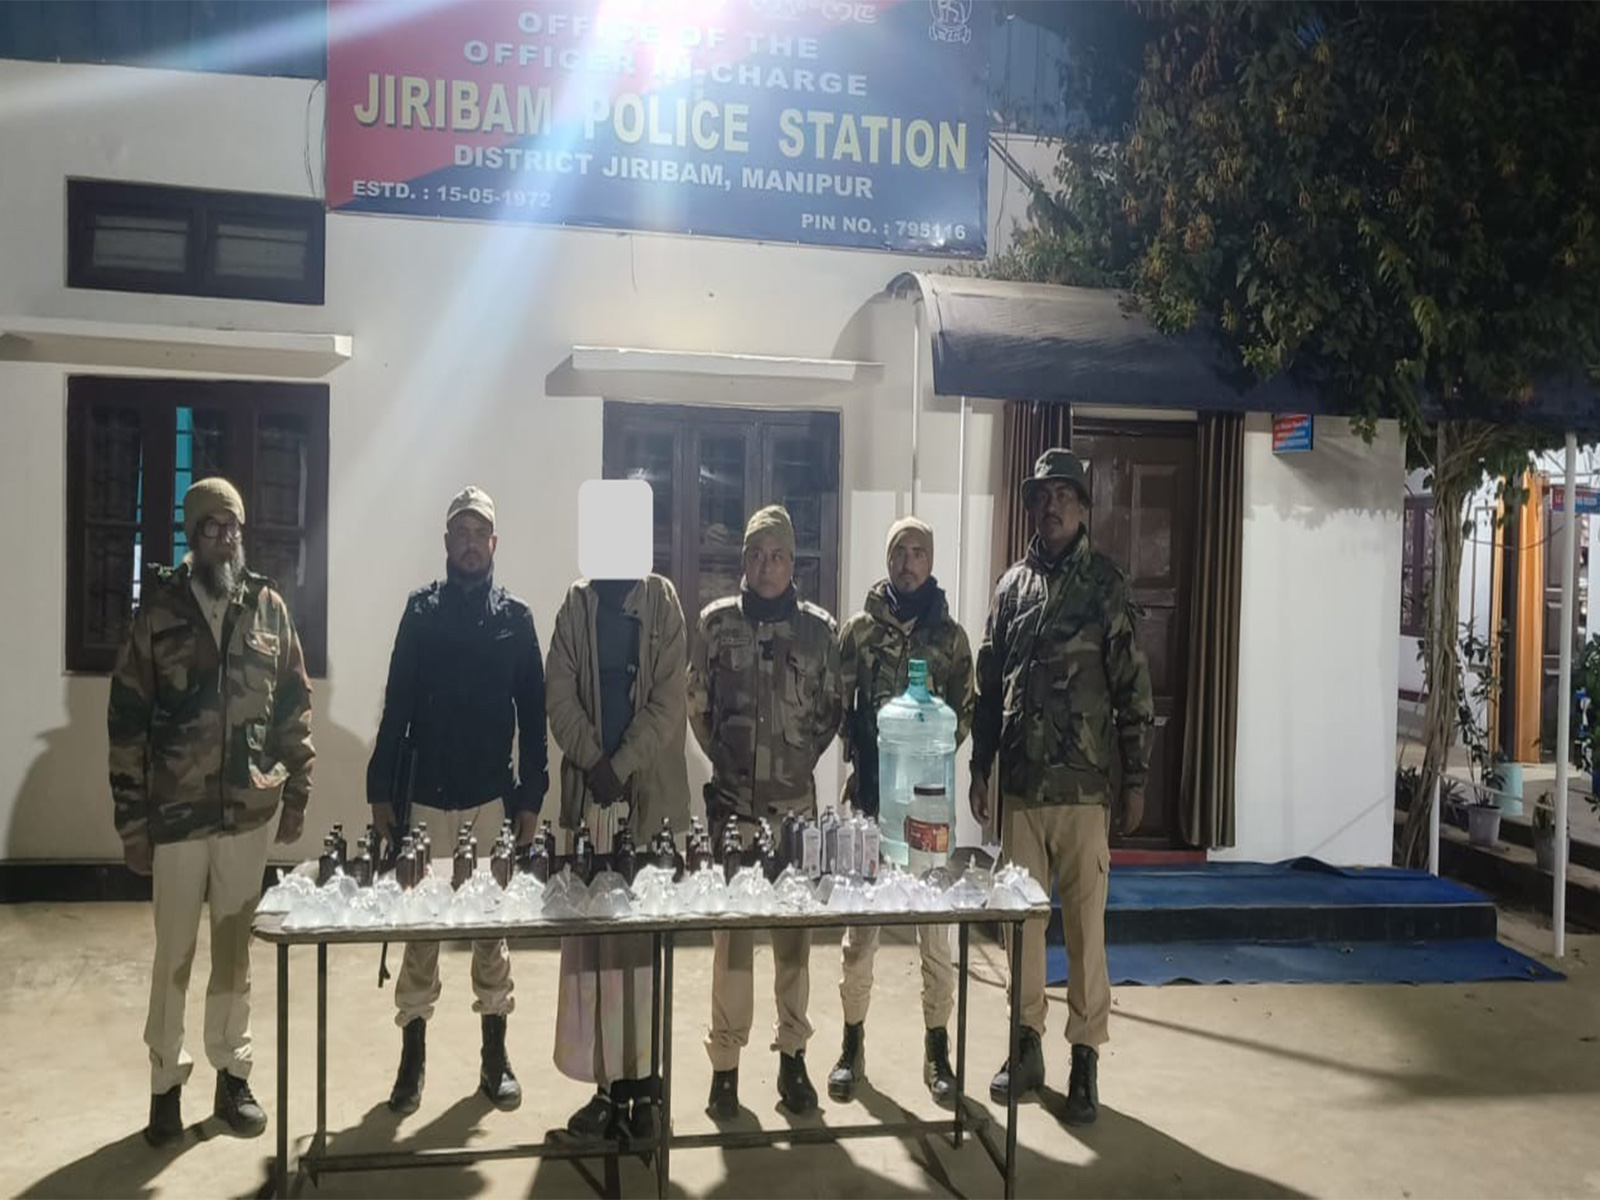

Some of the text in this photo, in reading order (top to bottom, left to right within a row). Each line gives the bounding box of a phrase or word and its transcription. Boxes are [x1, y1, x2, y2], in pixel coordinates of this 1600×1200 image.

[518, 11, 660, 44] OFFCE
[748, 31, 819, 60] THE
[463, 40, 636, 76] OFFICER
[353, 73, 967, 171] JIRIBAM POLICE STATION
[454, 144, 874, 199] DISTRICT JIRIBAM, MANIPUR
[353, 180, 415, 200] ESTD.
[437, 186, 552, 208] 15-05-1972
[801, 213, 837, 231] PIN
[843, 217, 877, 234] NO.
